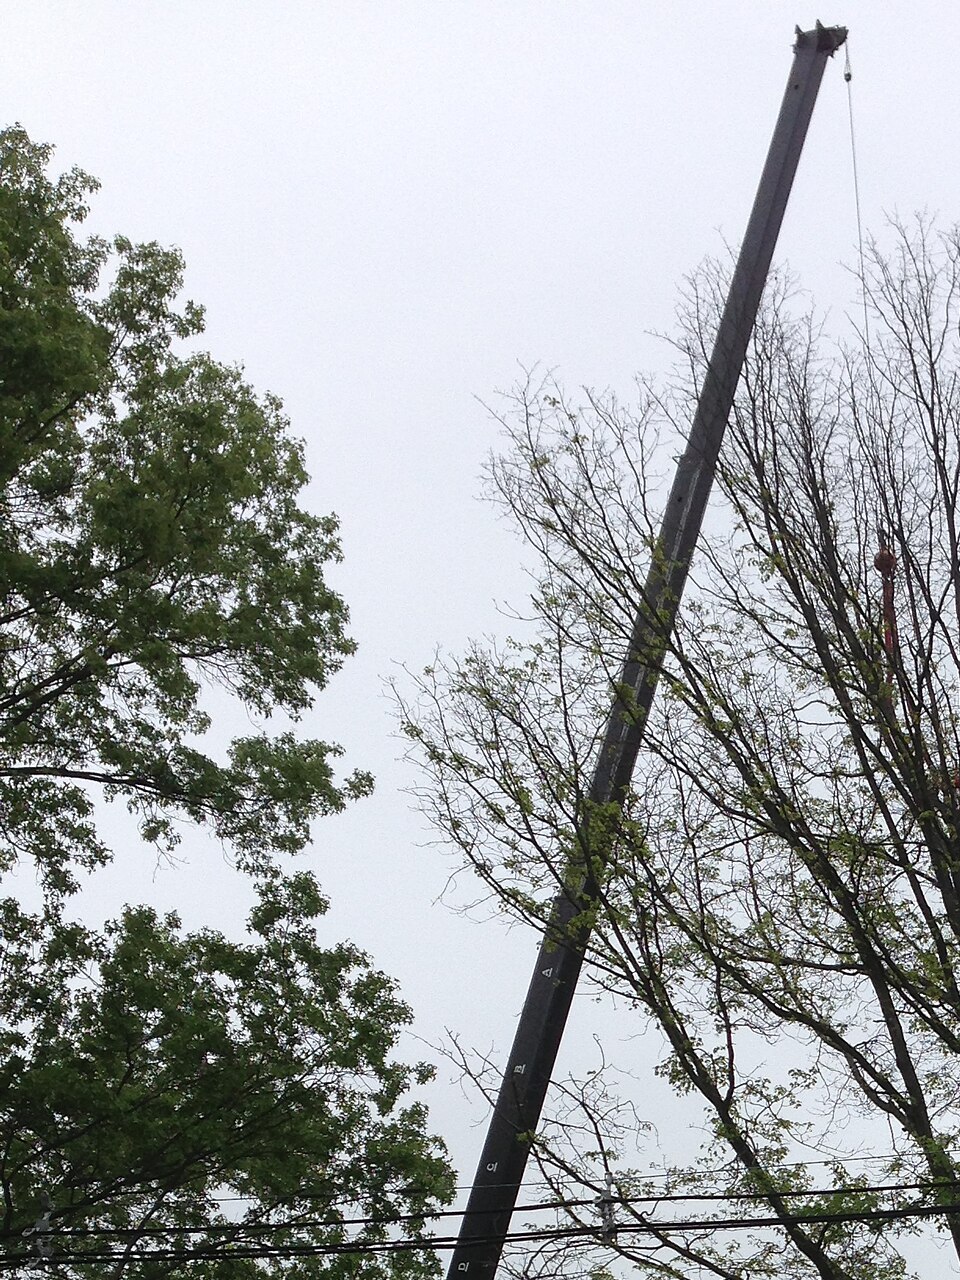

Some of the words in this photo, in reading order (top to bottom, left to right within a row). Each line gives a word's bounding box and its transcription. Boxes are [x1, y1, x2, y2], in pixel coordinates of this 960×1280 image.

[542, 967, 553, 978] A
[514, 1064, 525, 1074] B
[486, 1162, 497, 1172] C
[458, 1262, 469, 1272] D
